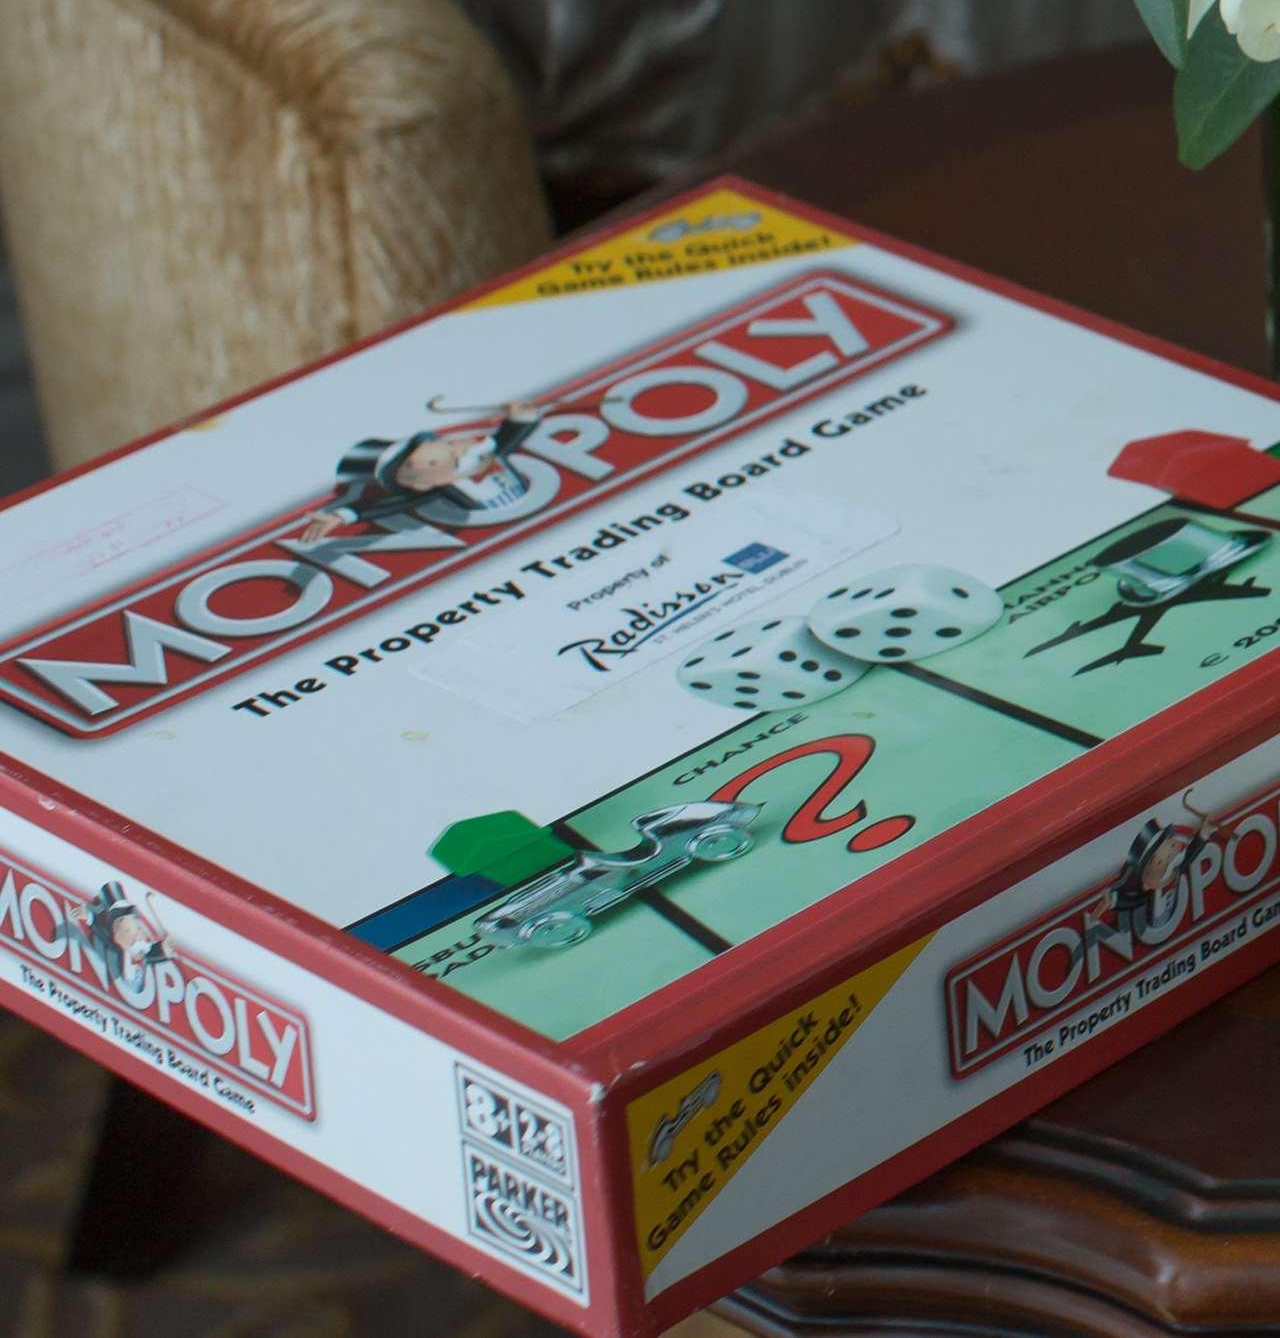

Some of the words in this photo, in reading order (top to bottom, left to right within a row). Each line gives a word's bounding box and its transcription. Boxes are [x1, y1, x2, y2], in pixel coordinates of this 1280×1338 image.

[15, 290, 868, 715] MONOPOLY
[231, 677, 327, 717] The
[324, 580, 526, 676] Property
[520, 502, 691, 580] Trading
[684, 438, 811, 502] Board
[812, 382, 928, 439] Game
[558, 571, 745, 672] Radisson
[566, 567, 649, 612] Property
[673, 712, 809, 786] CHANCE
[1023, 1036, 1055, 1068] The
[1058, 990, 1132, 1048] Property
[1135, 953, 1197, 1000] Trading
[1200, 918, 1248, 961] Board
[646, 1171, 717, 1252] Game
[715, 1093, 783, 1172] Rules
[782, 992, 863, 1093] inside!
[662, 1148, 701, 1193] Try
[703, 1098, 746, 1147] the
[748, 1010, 819, 1095] Quick
[471, 1155, 570, 1228] PARKER
